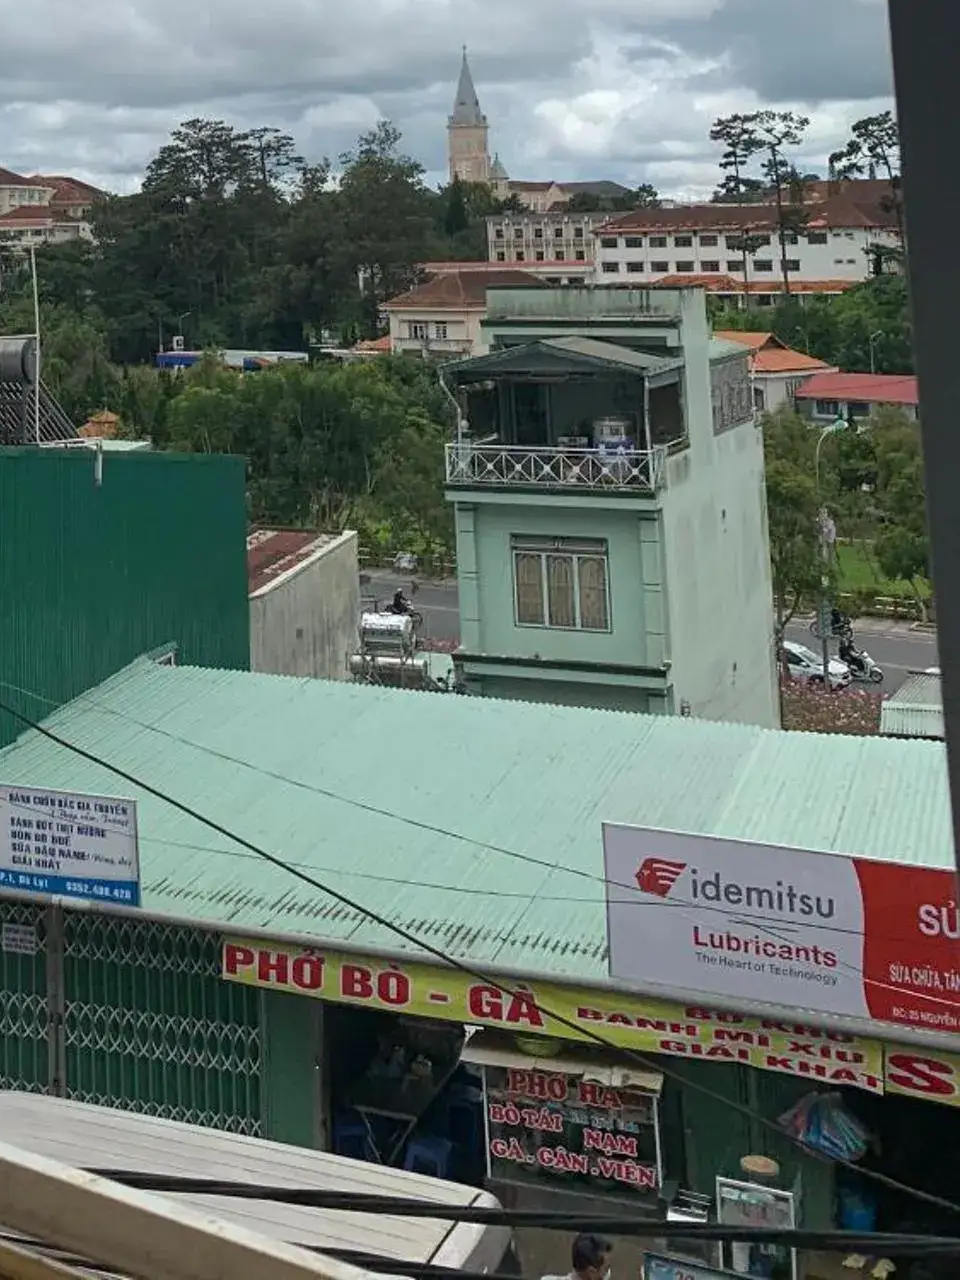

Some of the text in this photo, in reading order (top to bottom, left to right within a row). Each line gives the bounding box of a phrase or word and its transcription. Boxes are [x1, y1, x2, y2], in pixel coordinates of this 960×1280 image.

[691, 868, 834, 918] idemitsu
[693, 926, 837, 967] Lubricants
[696, 951, 837, 986] The Heart of Technology
[224, 944, 325, 990] PHỞ
[340, 963, 411, 1006] BÒ
[469, 984, 544, 1027] GÀ
